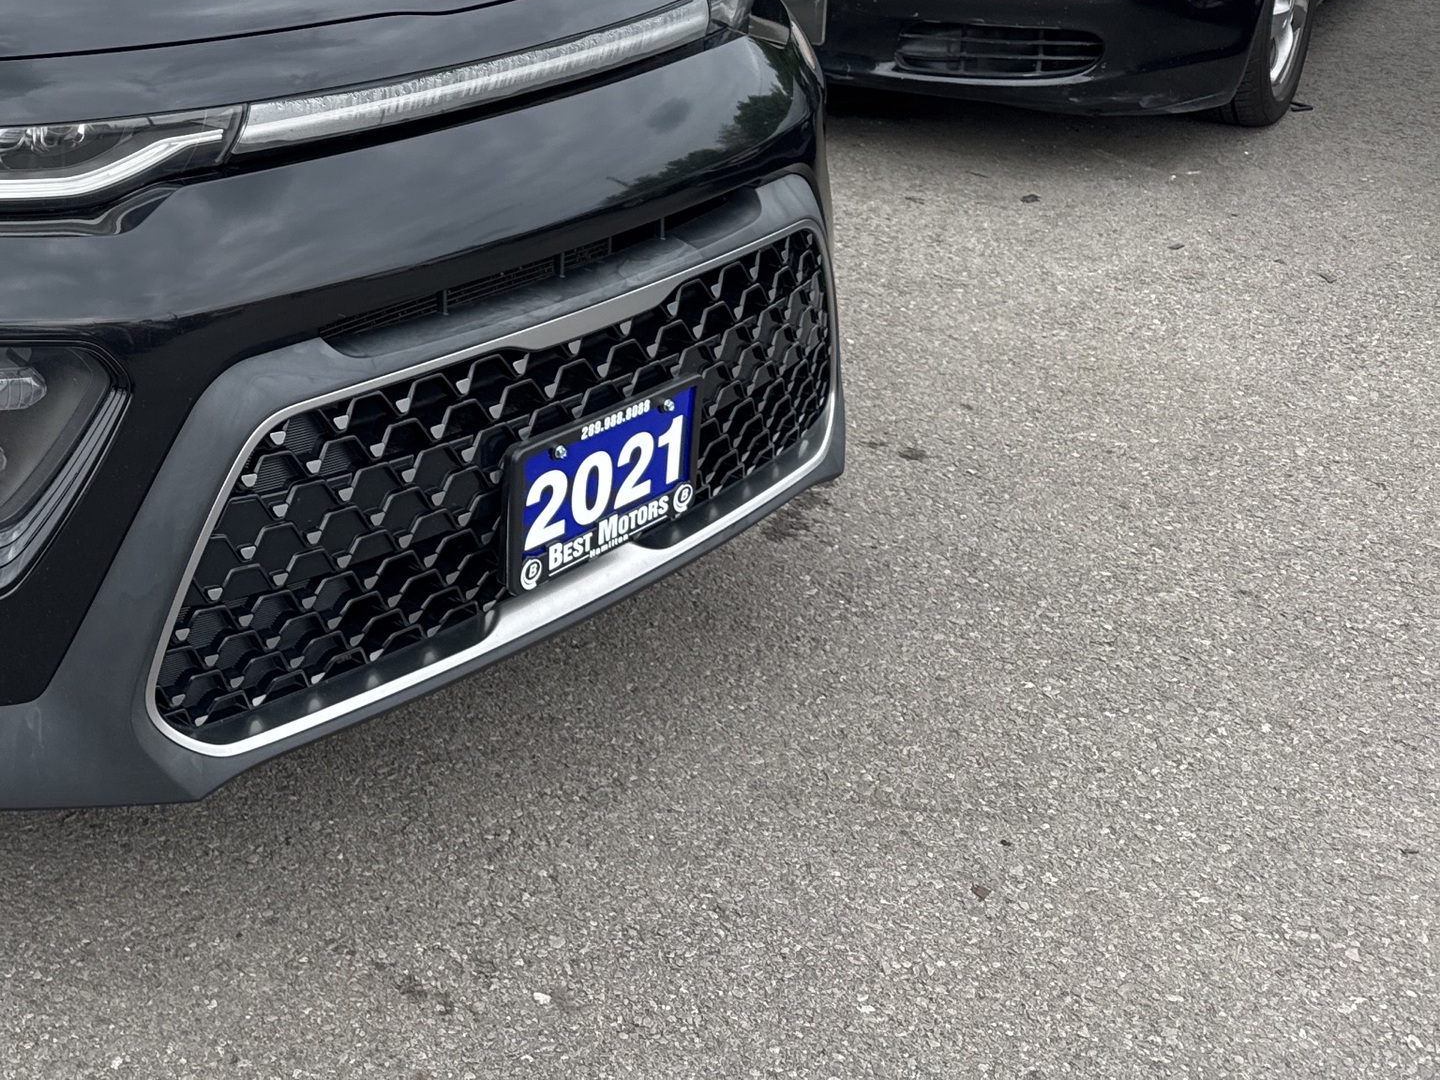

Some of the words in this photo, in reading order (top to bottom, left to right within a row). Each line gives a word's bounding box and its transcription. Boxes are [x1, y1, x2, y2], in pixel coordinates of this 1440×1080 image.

[580, 398, 651, 441] 289.988.8088
[524, 414, 684, 552] 2021
[589, 533, 629, 559] Hamilton
